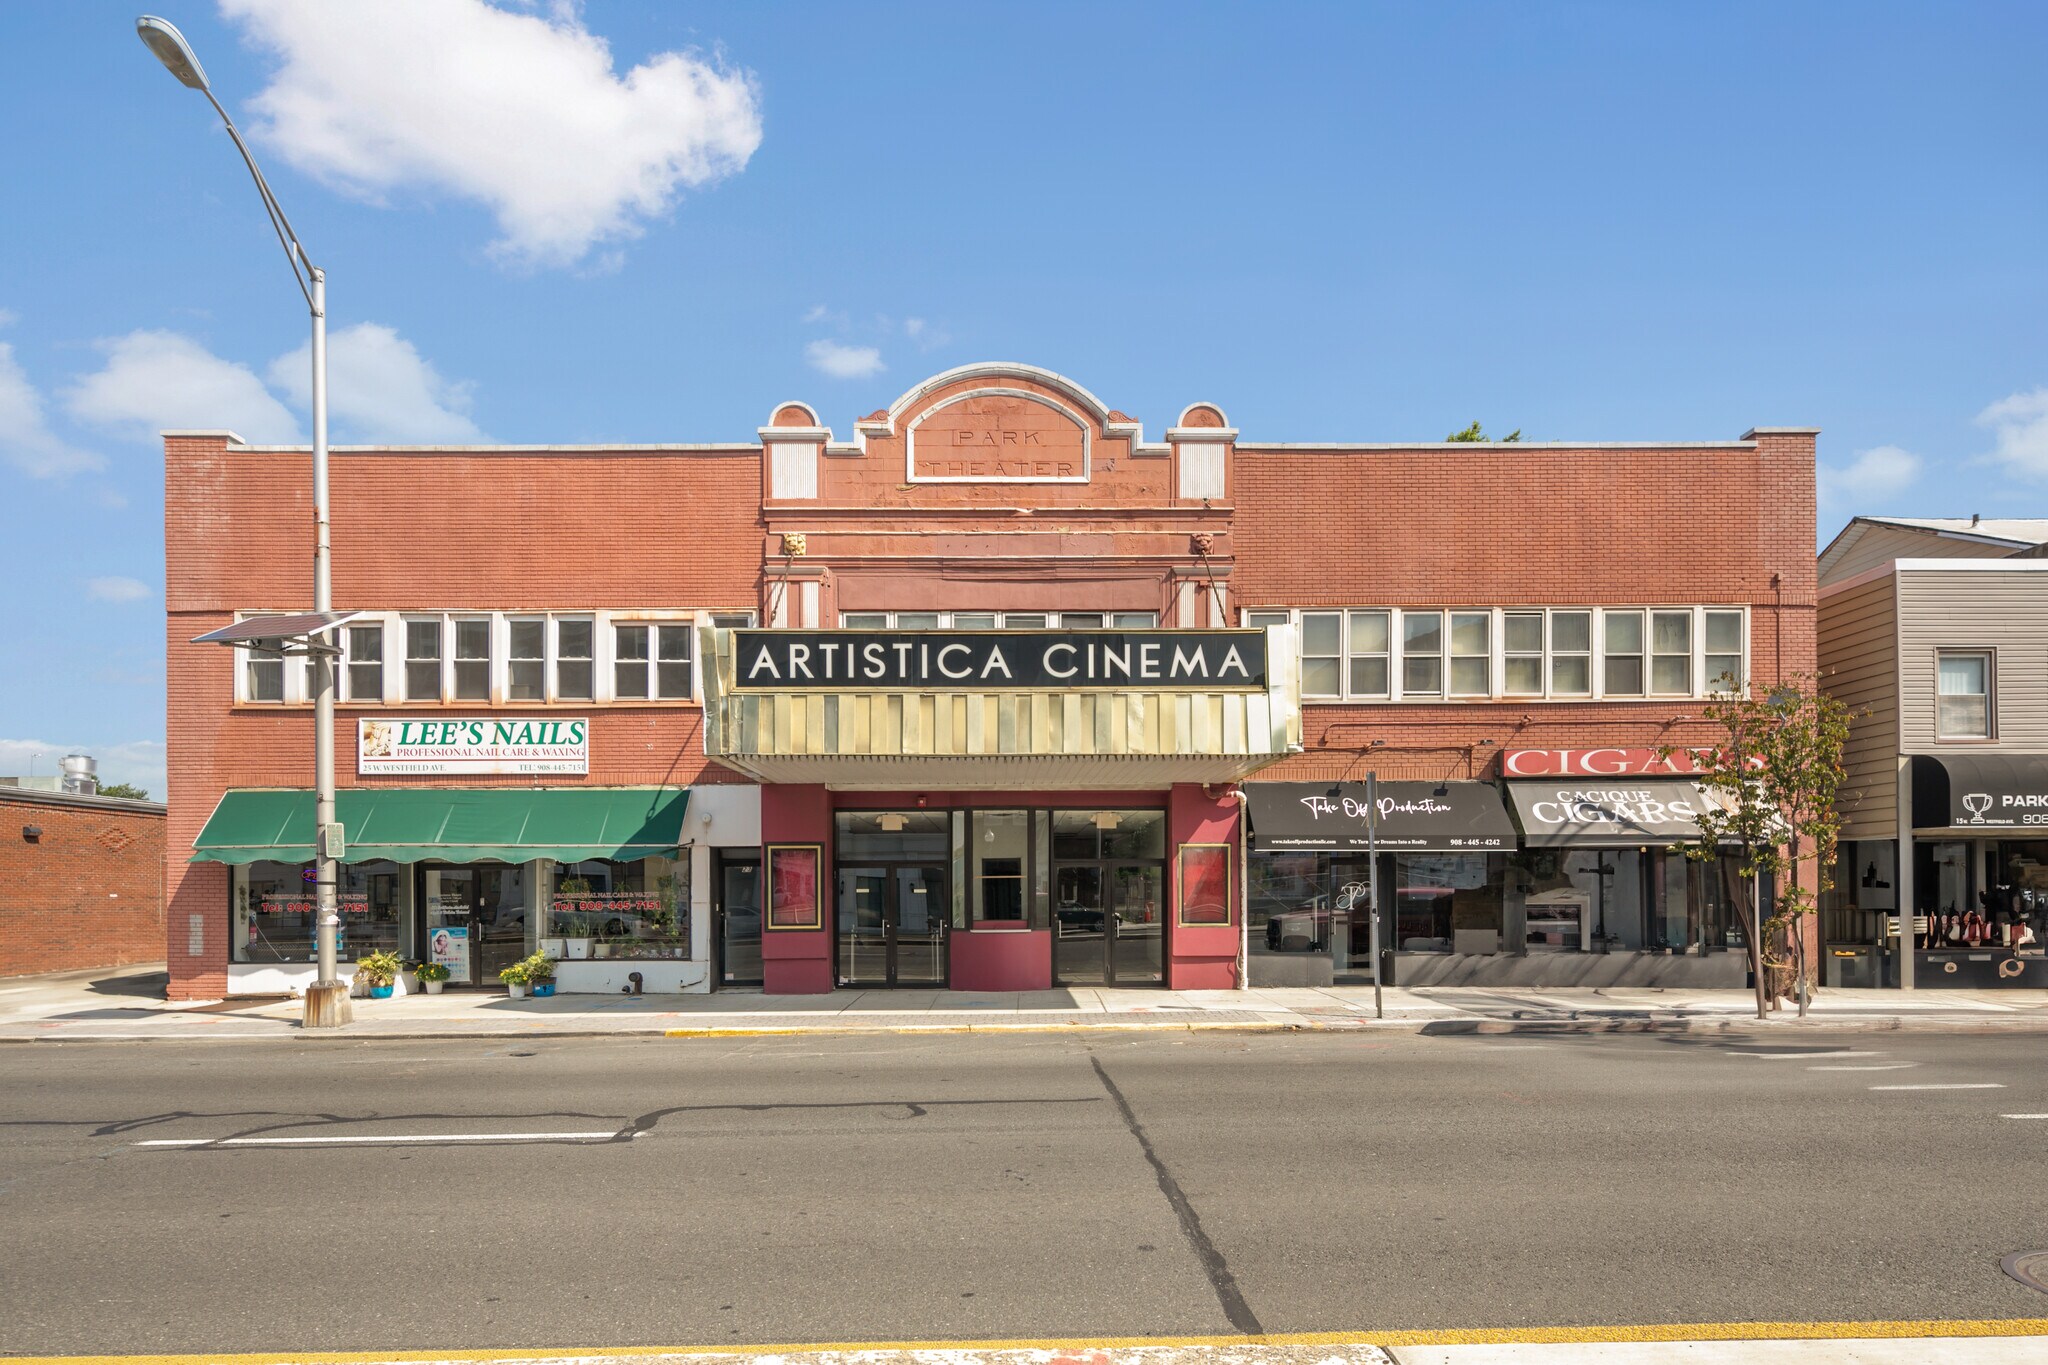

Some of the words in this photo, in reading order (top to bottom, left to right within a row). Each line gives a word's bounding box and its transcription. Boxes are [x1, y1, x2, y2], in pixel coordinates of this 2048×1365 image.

[958, 431, 1040, 445] PARK
[929, 462, 1073, 476] THEATER
[748, 643, 1012, 679] ARTISTICA
[1042, 643, 1250, 679] CINEMA
[398, 721, 483, 746] LEE'S
[490, 721, 585, 746] NAILS
[397, 748, 474, 757] PROFESSIONAL
[476, 748, 499, 757] NAIL
[502, 748, 530, 757] CARE
[532, 748, 540, 757] &
[542, 748, 584, 757] WAXING
[1556, 790, 1654, 803] CACIQUE
[2002, 795, 2048, 807] PARK
[1300, 797, 1339, 820] Take
[1343, 797, 1368, 817] Off
[1376, 797, 1451, 820] Production
[1532, 800, 1698, 824] CIGARS
[261, 902, 282, 913] Tel:
[286, 902, 369, 913] 908--7151
[554, 901, 575, 912] Tel:
[579, 900, 662, 911] 908-445-7151
